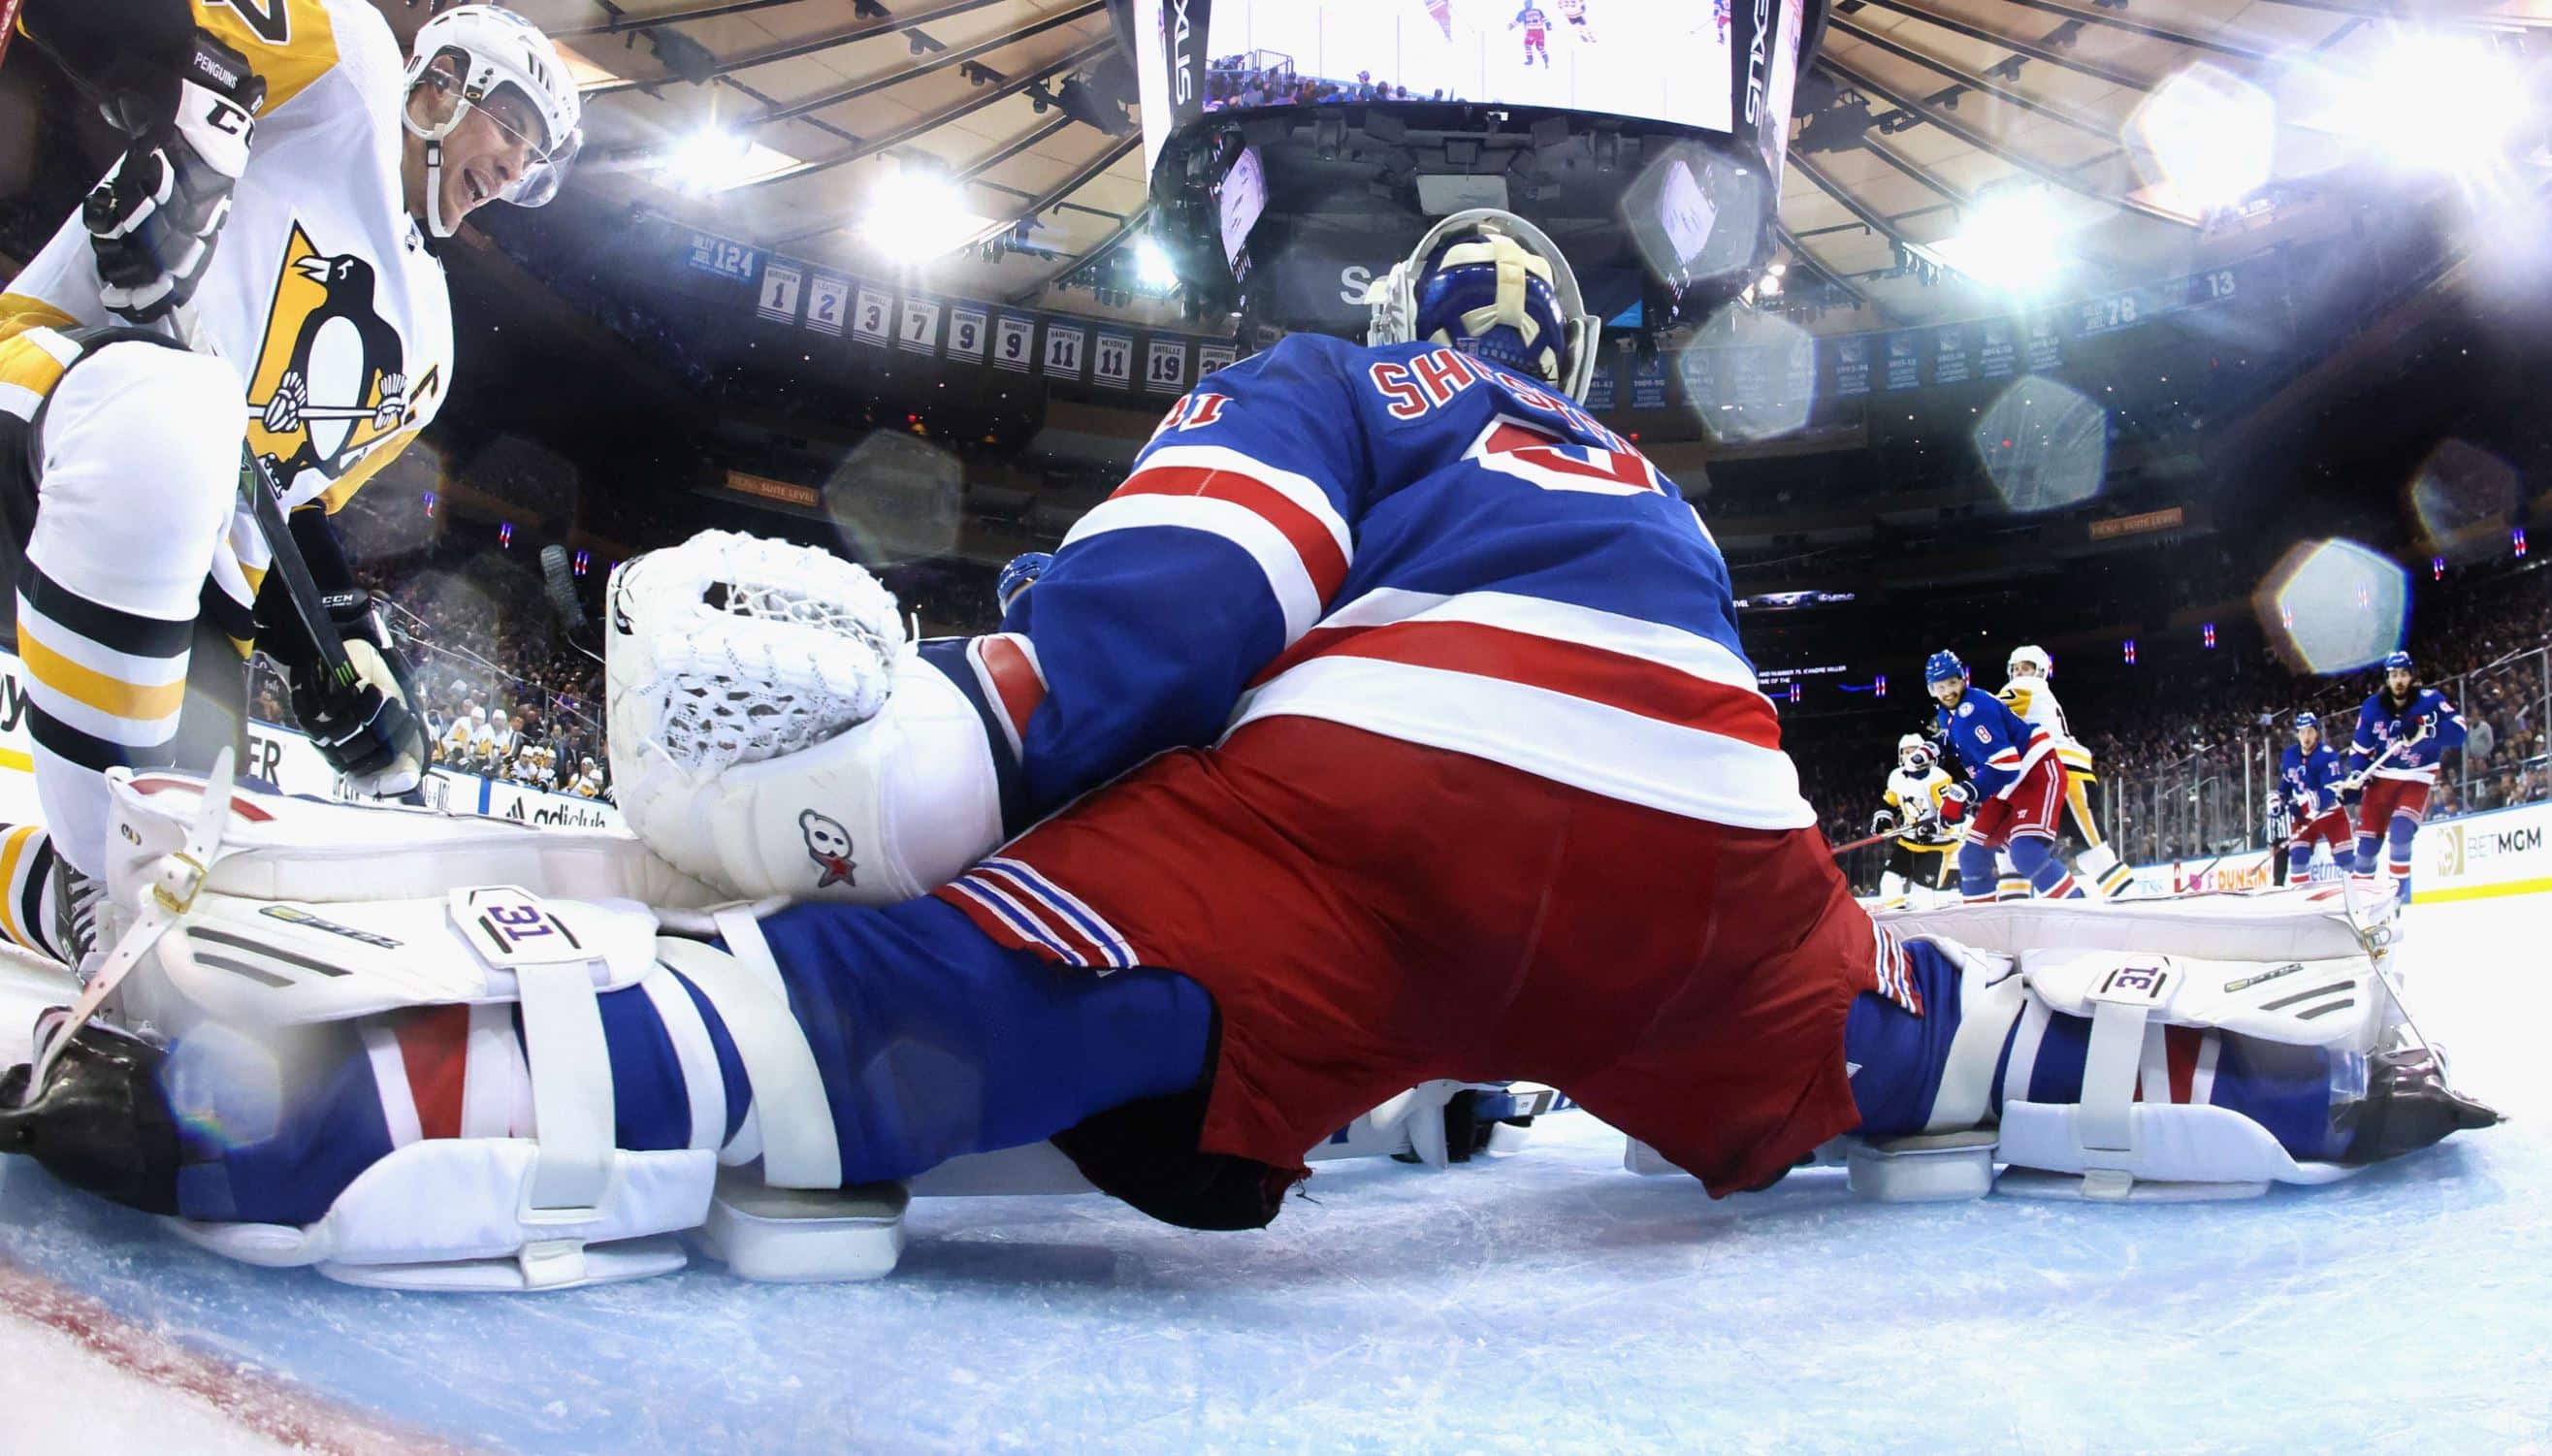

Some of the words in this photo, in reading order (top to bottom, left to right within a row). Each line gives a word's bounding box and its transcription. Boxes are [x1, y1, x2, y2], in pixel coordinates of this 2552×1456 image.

[194, 51, 239, 90] PENGUINS
[713, 243, 754, 277] 124
[772, 281, 785, 309] 1
[2208, 271, 2236, 297] 13
[818, 294, 836, 321] 2
[864, 305, 881, 332] 3
[912, 313, 928, 340] 7
[959, 323, 976, 349] 9
[1005, 332, 1021, 359] 9
[1050, 340, 1075, 368] 11
[1099, 348, 1123, 376] 11
[1151, 355, 1180, 381] 19
[321, 594, 354, 604] CCM
[1975, 725, 1992, 744] 8
[486, 905, 555, 941] 31
[2115, 966, 2159, 990] 31
